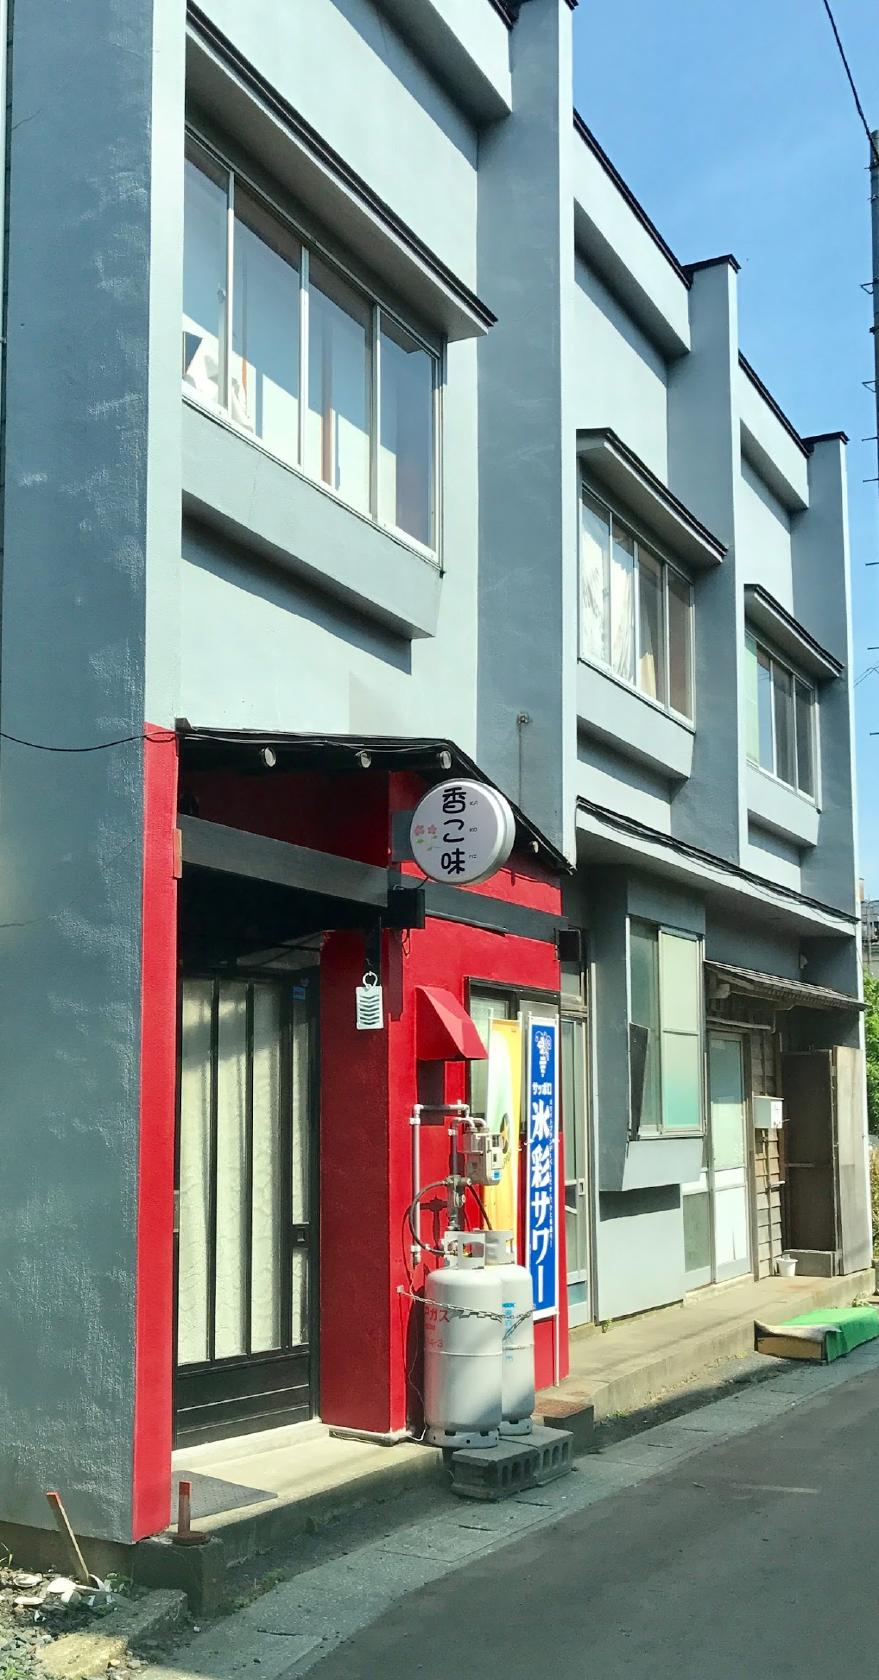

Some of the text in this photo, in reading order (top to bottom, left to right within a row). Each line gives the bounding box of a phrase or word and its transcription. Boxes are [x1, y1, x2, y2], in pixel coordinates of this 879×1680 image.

[441, 786, 467, 875] 香こ味
[532, 1082, 553, 1096] サッポロ
[531, 1098, 551, 1304] 氷彩サワー
